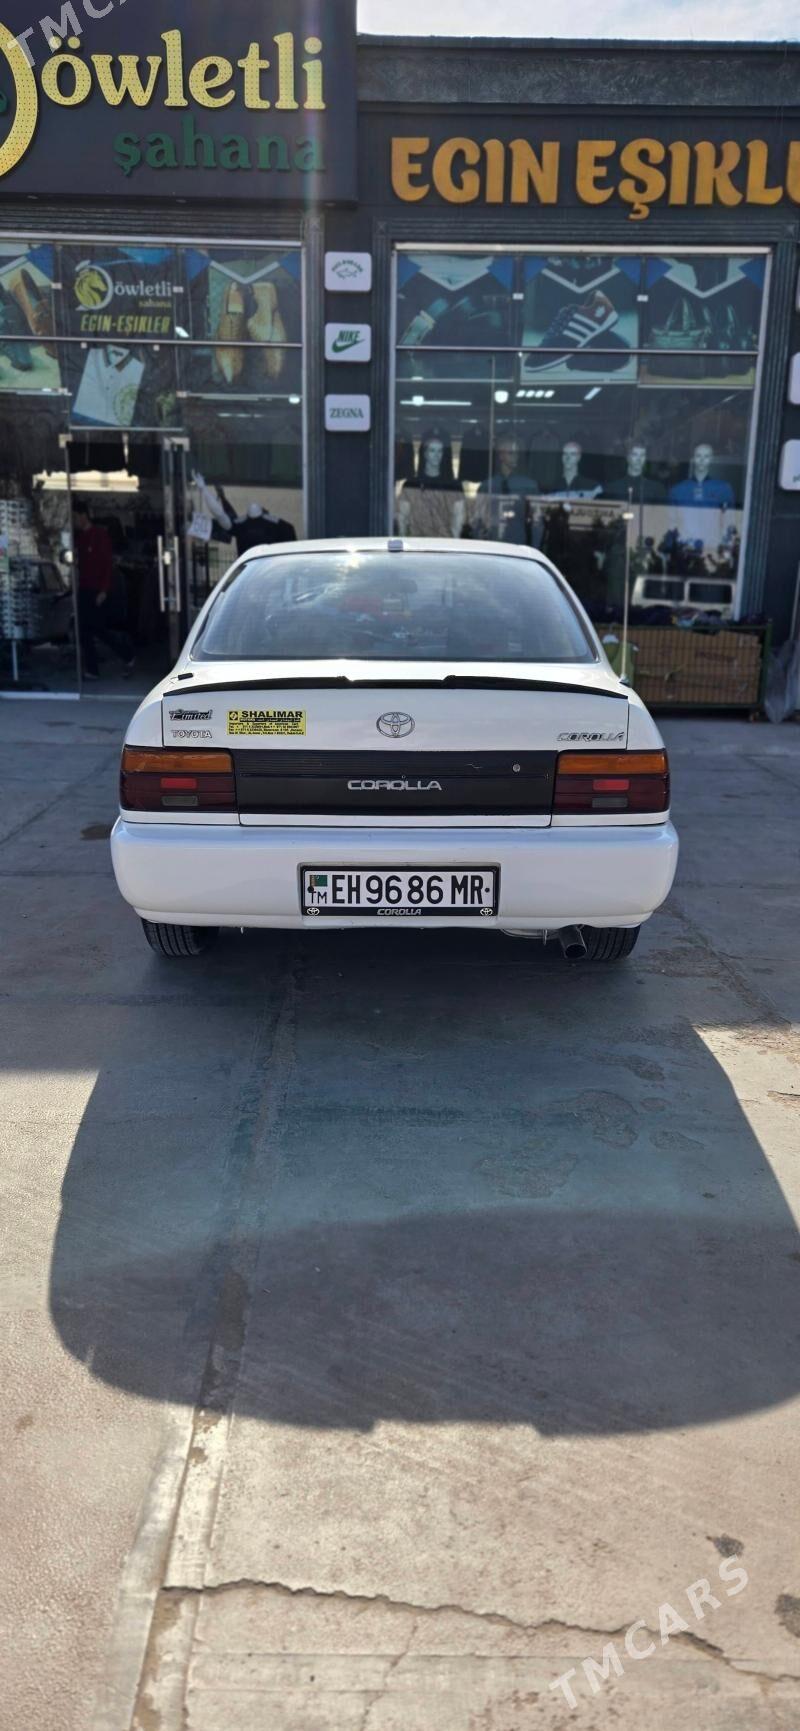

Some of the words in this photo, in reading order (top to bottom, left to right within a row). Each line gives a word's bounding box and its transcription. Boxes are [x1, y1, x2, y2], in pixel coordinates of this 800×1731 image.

[113, 114, 326, 177] şahana
[391, 137, 560, 204] EGIN
[337, 330, 361, 342] NIKE
[330, 408, 364, 419] ZEGNA
[169, 708, 213, 721] Limited
[241, 710, 303, 718] SHALIMAR
[171, 729, 212, 739] TOYOTA
[557, 731, 625, 742] COROLLA
[346, 779, 442, 791] COROLLA
[310, 891, 328, 904] TM
[376, 908, 422, 916] COROLLA
